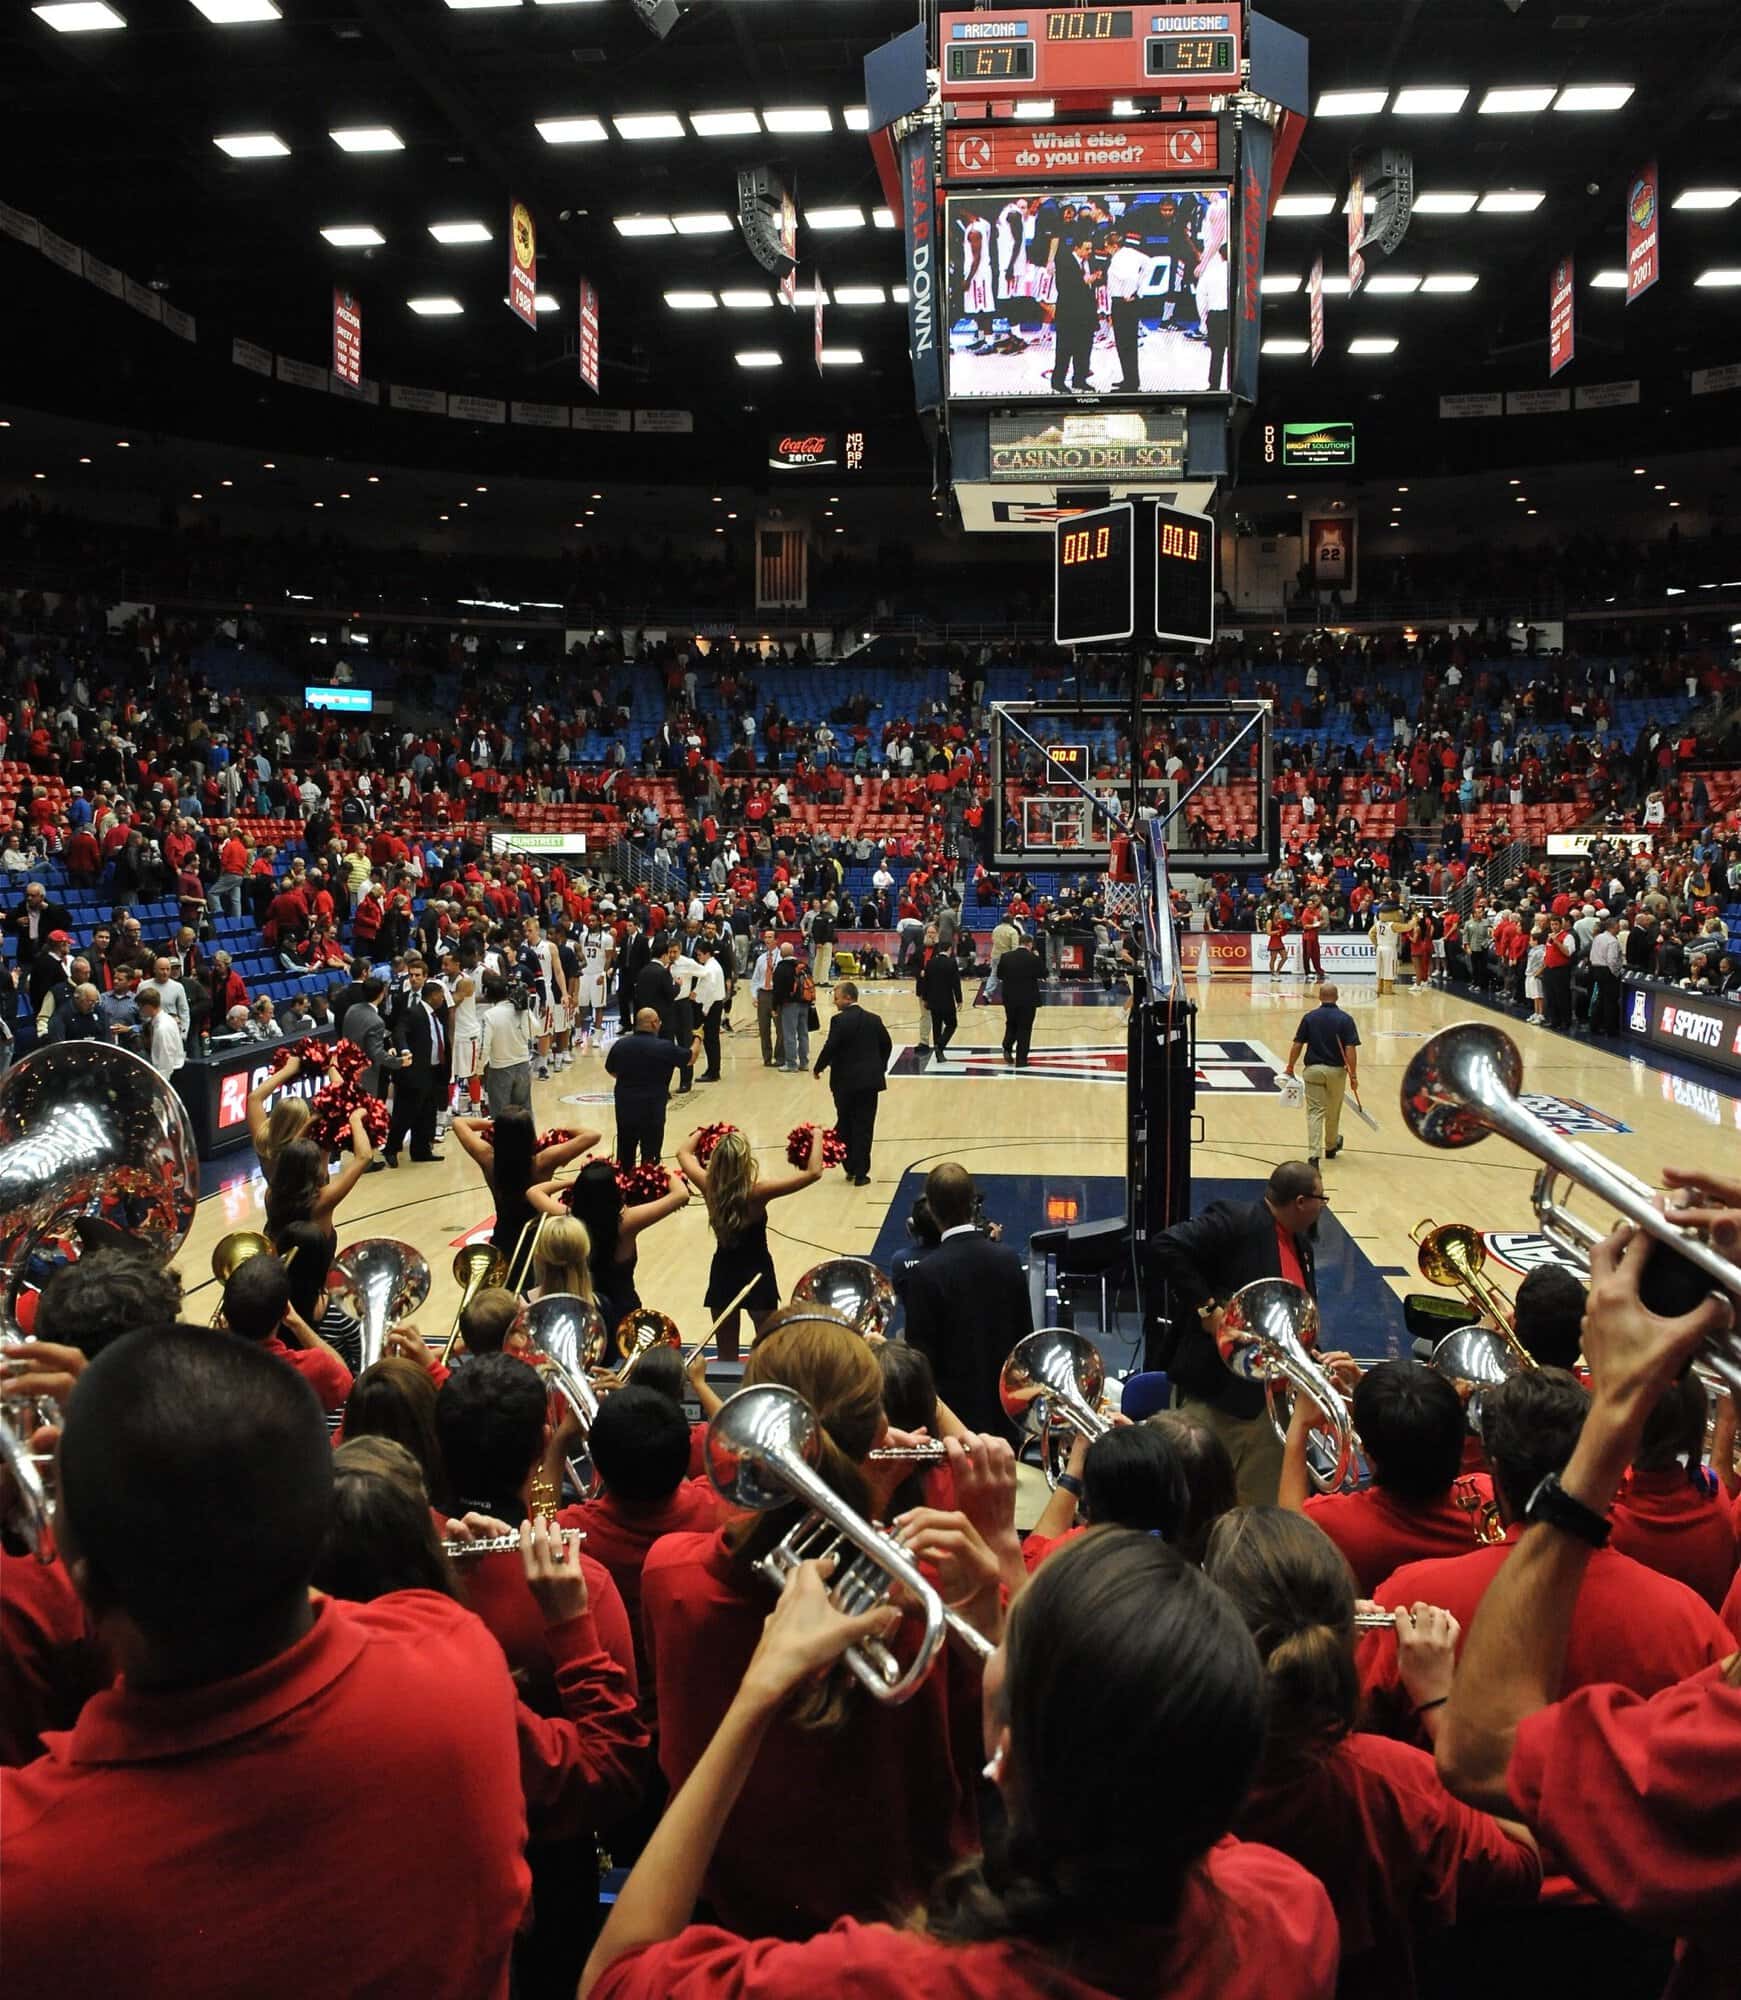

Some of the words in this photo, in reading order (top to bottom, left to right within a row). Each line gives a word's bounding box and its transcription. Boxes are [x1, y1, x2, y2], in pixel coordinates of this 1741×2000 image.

[964, 22, 1016, 37] ARIZONA
[1048, 13, 1112, 40] 00.0
[1157, 16, 1222, 31] DUQUESNE
[976, 48, 1013, 75] 67
[1176, 42, 1212, 68] 59
[1032, 131, 1082, 149] What
[1088, 132, 1127, 147] else
[1015, 150, 1040, 166] do
[1045, 152, 1079, 168] you
[1084, 147, 1144, 164] need?
[1632, 256, 1652, 289] 2001
[846, 442, 864, 451] PTS
[847, 433, 863, 443] NO
[993, 450, 1062, 468] CASINO
[1090, 448, 1133, 466] DEL
[1063, 527, 1110, 565] 00.0
[1162, 524, 1199, 561] 00.0
[1320, 548, 1341, 561] 22
[1052, 750, 1078, 762] 00.0
[586, 947, 597, 959] 33
[1189, 944, 1248, 959] FRGO
[1673, 1009, 1724, 1048] SPORTS
[222, 1078, 246, 1122] 2K
